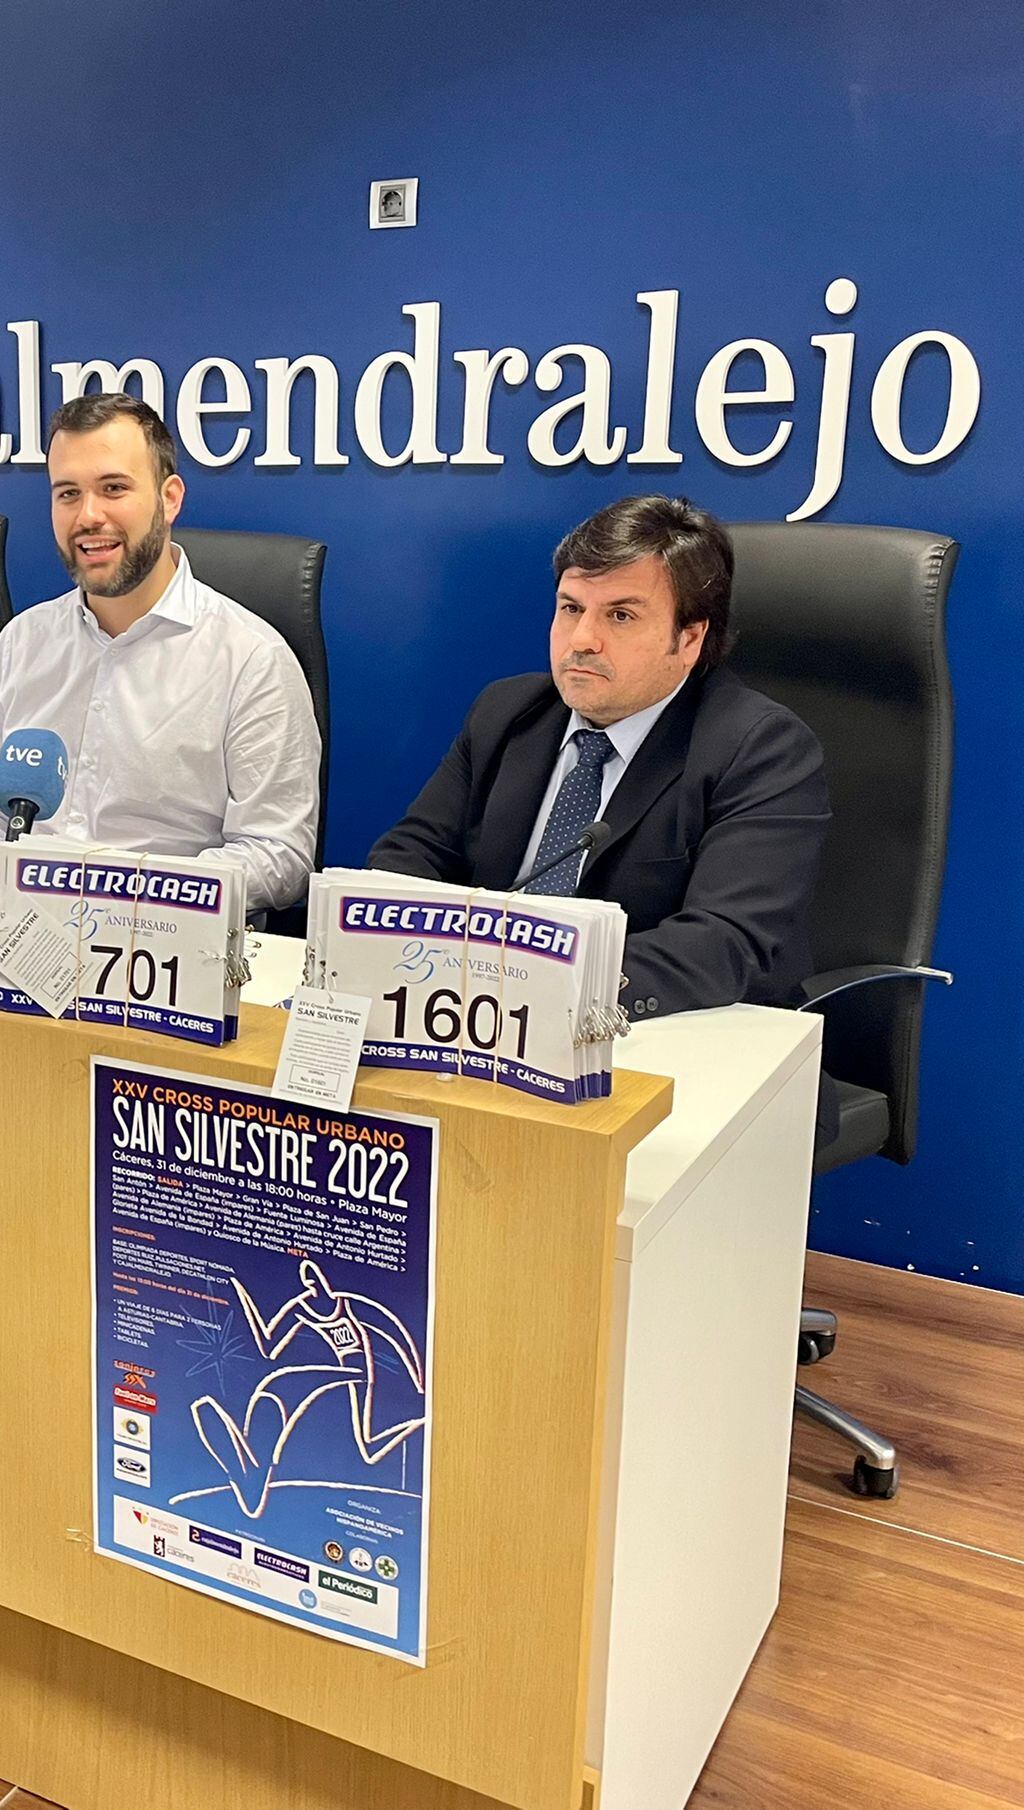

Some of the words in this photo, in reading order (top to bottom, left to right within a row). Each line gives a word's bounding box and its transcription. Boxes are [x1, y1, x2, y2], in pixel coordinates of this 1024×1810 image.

[5, 745, 43, 767] tve
[21, 865, 218, 906] ELECTROCASH
[104, 916, 177, 934] ANIVERSARIO
[345, 902, 575, 956] ELECTROCASH
[90, 945, 178, 1007] 701
[442, 956, 528, 981] ANVERSARIO
[11, 993, 33, 1005] XXV
[79, 1002, 102, 1013] SAN
[106, 1004, 161, 1023] SILVESTRE
[296, 1006, 315, 1017] SAN
[316, 1010, 359, 1025] SILVESTRE
[383, 985, 529, 1060] 1601
[361, 1044, 406, 1059] CROSS
[409, 1048, 438, 1061] SAN
[442, 1051, 509, 1075] SILVESTRE
[112, 1078, 147, 1099] XXV
[152, 1086, 213, 1112] CROSS
[219, 1099, 309, 1131] POPULAR
[316, 1117, 404, 1150] URBANO
[112, 1094, 164, 1156] SAN
[174, 1106, 317, 1188] SILVESTRE
[327, 1137, 409, 1208] 2022
[112, 1149, 154, 1168] Cáceres,
[156, 1158, 166, 1170] 31
[168, 1161, 181, 1173] de
[184, 1164, 235, 1185] diciembre
[237, 1178, 244, 1187] a
[247, 1178, 261, 1191] las
[264, 1182, 293, 1198] 18:00
[297, 1189, 326, 1205] horas
[338, 1198, 368, 1215] Plaza
[372, 1206, 407, 1225] Mayor
[112, 1165, 155, 1181] RECORRIDO:
[157, 1175, 183, 1188] SALIDA
[192, 1183, 210, 1194] Plaza
[212, 1187, 233, 1199] Mayor
[242, 1194, 259, 1205] Gran
[282, 1203, 301, 1214] Plaza
[303, 1208, 313, 1217] de
[315, 1210, 329, 1221] San
[331, 1214, 349, 1225] Juan
[359, 1220, 373, 1231] San
[376, 1224, 399, 1236] Pedro
[330, 1327, 356, 1347] 2022
[256, 1551, 307, 1575] ELECTROCASH
[322, 1575, 329, 1585] el
[332, 1576, 373, 1600] Periódico
